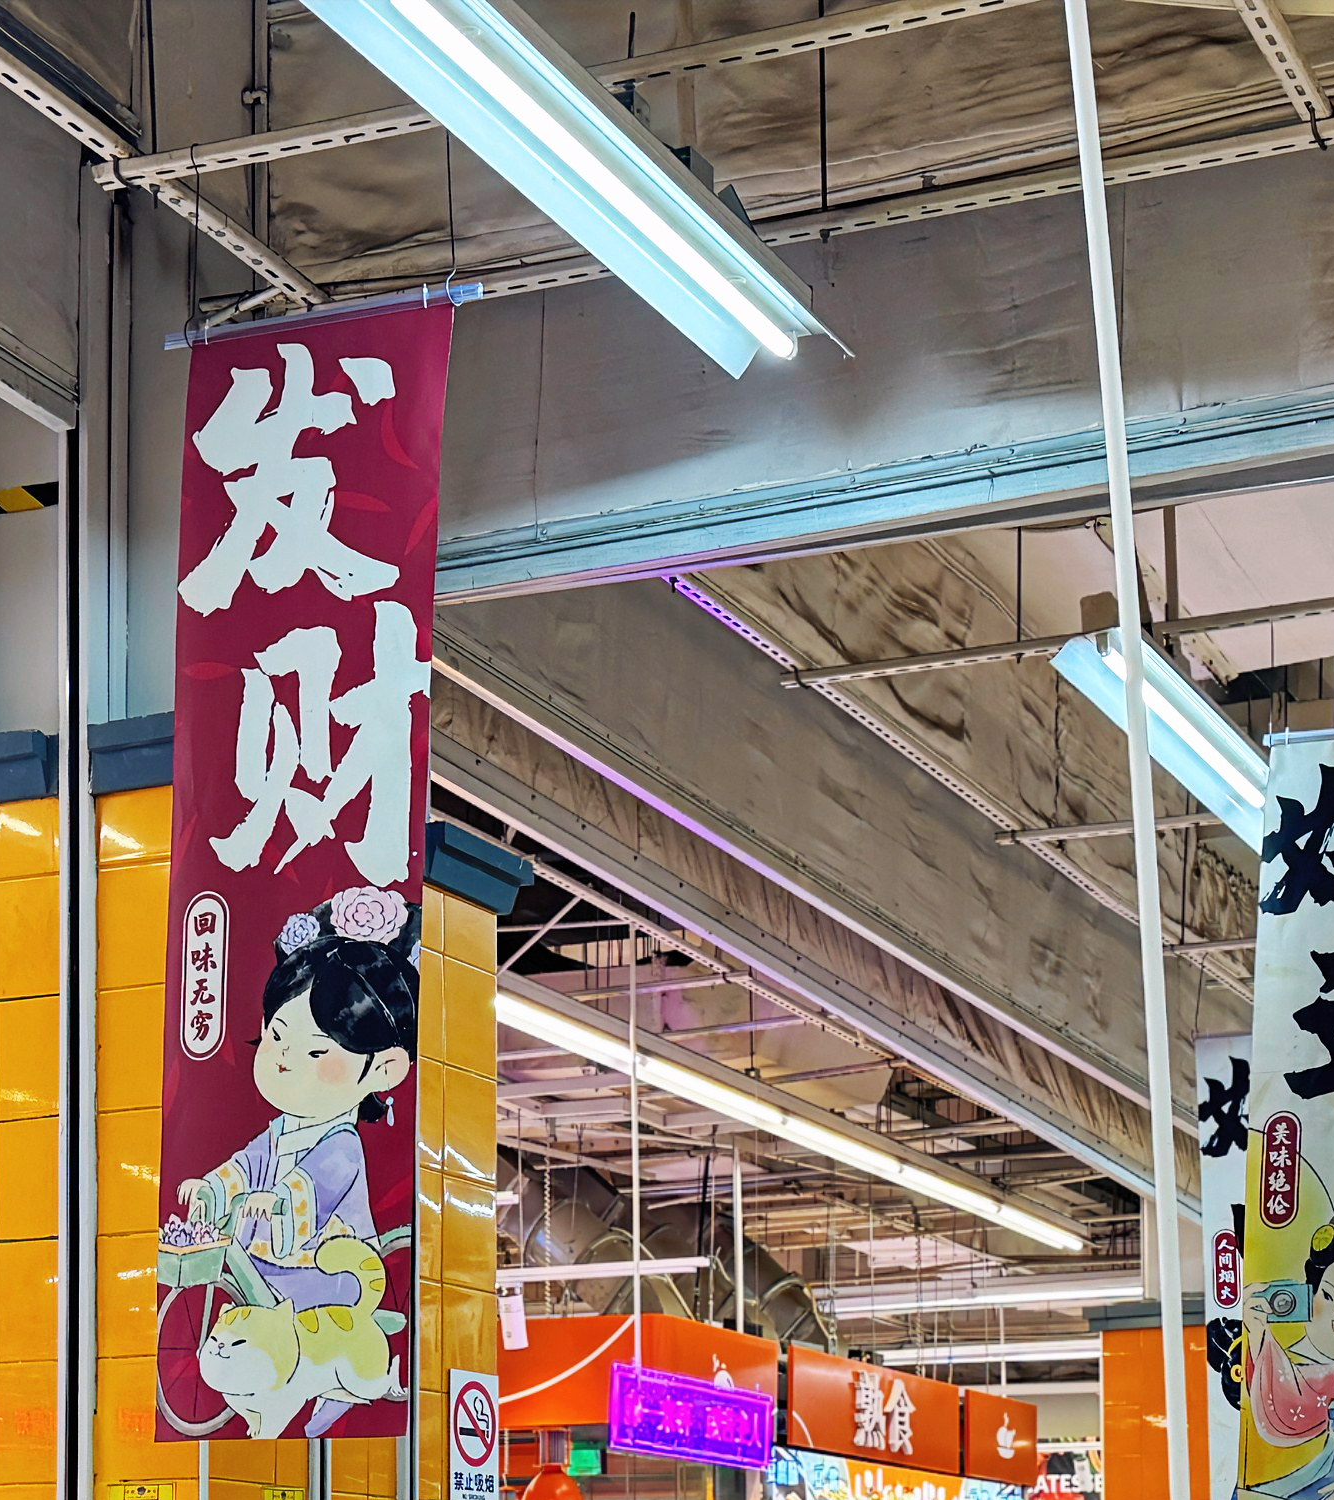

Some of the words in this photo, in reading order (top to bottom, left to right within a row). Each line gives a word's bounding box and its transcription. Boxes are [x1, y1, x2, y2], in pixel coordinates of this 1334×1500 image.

[177, 343, 431, 887] 发财
[189, 910, 216, 1043] 回味无穷
[1268, 1121, 1292, 1216] 美味绝伦
[1217, 1238, 1235, 1300] 人间烟火
[852, 1369, 916, 1455] 熟食
[454, 1471, 495, 1493] 禁止吸烟
